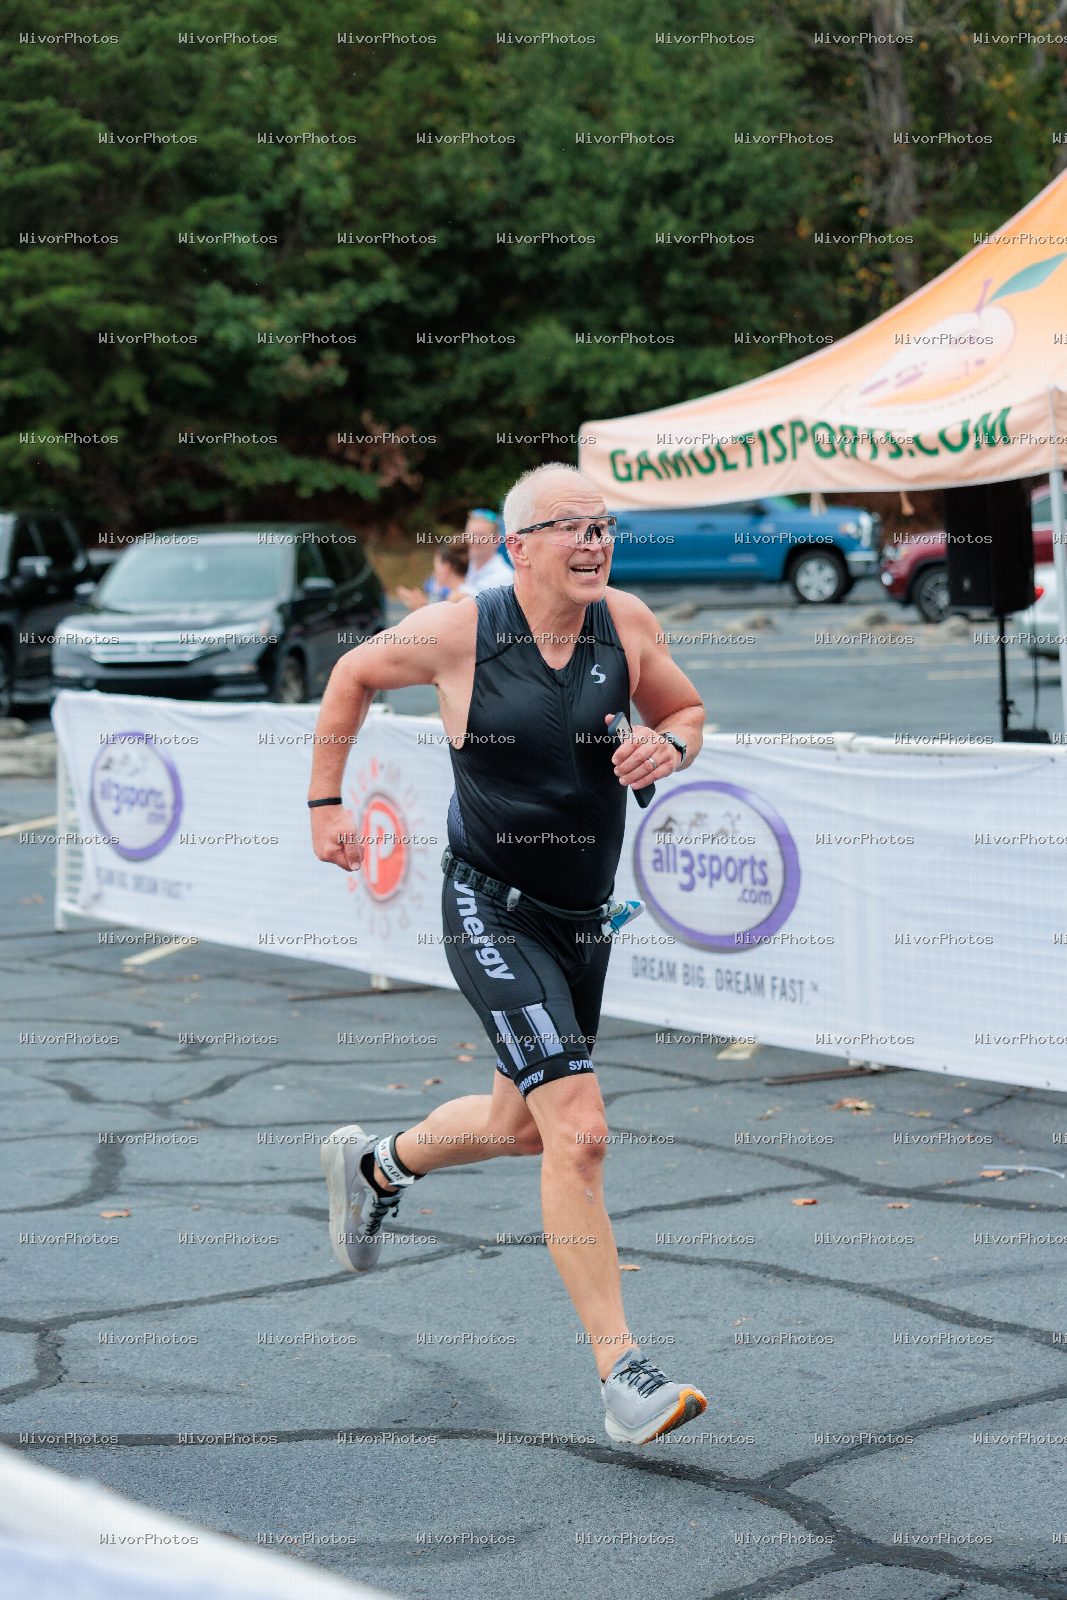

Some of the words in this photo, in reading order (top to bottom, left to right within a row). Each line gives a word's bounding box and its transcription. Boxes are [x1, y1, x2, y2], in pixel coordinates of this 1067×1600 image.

[652, 844, 769, 892] all3sports
[453, 880, 515, 980] ynergy
[631, 954, 677, 983] DREAM
[715, 968, 765, 998] DREAM
[568, 1059, 594, 1071] syne
